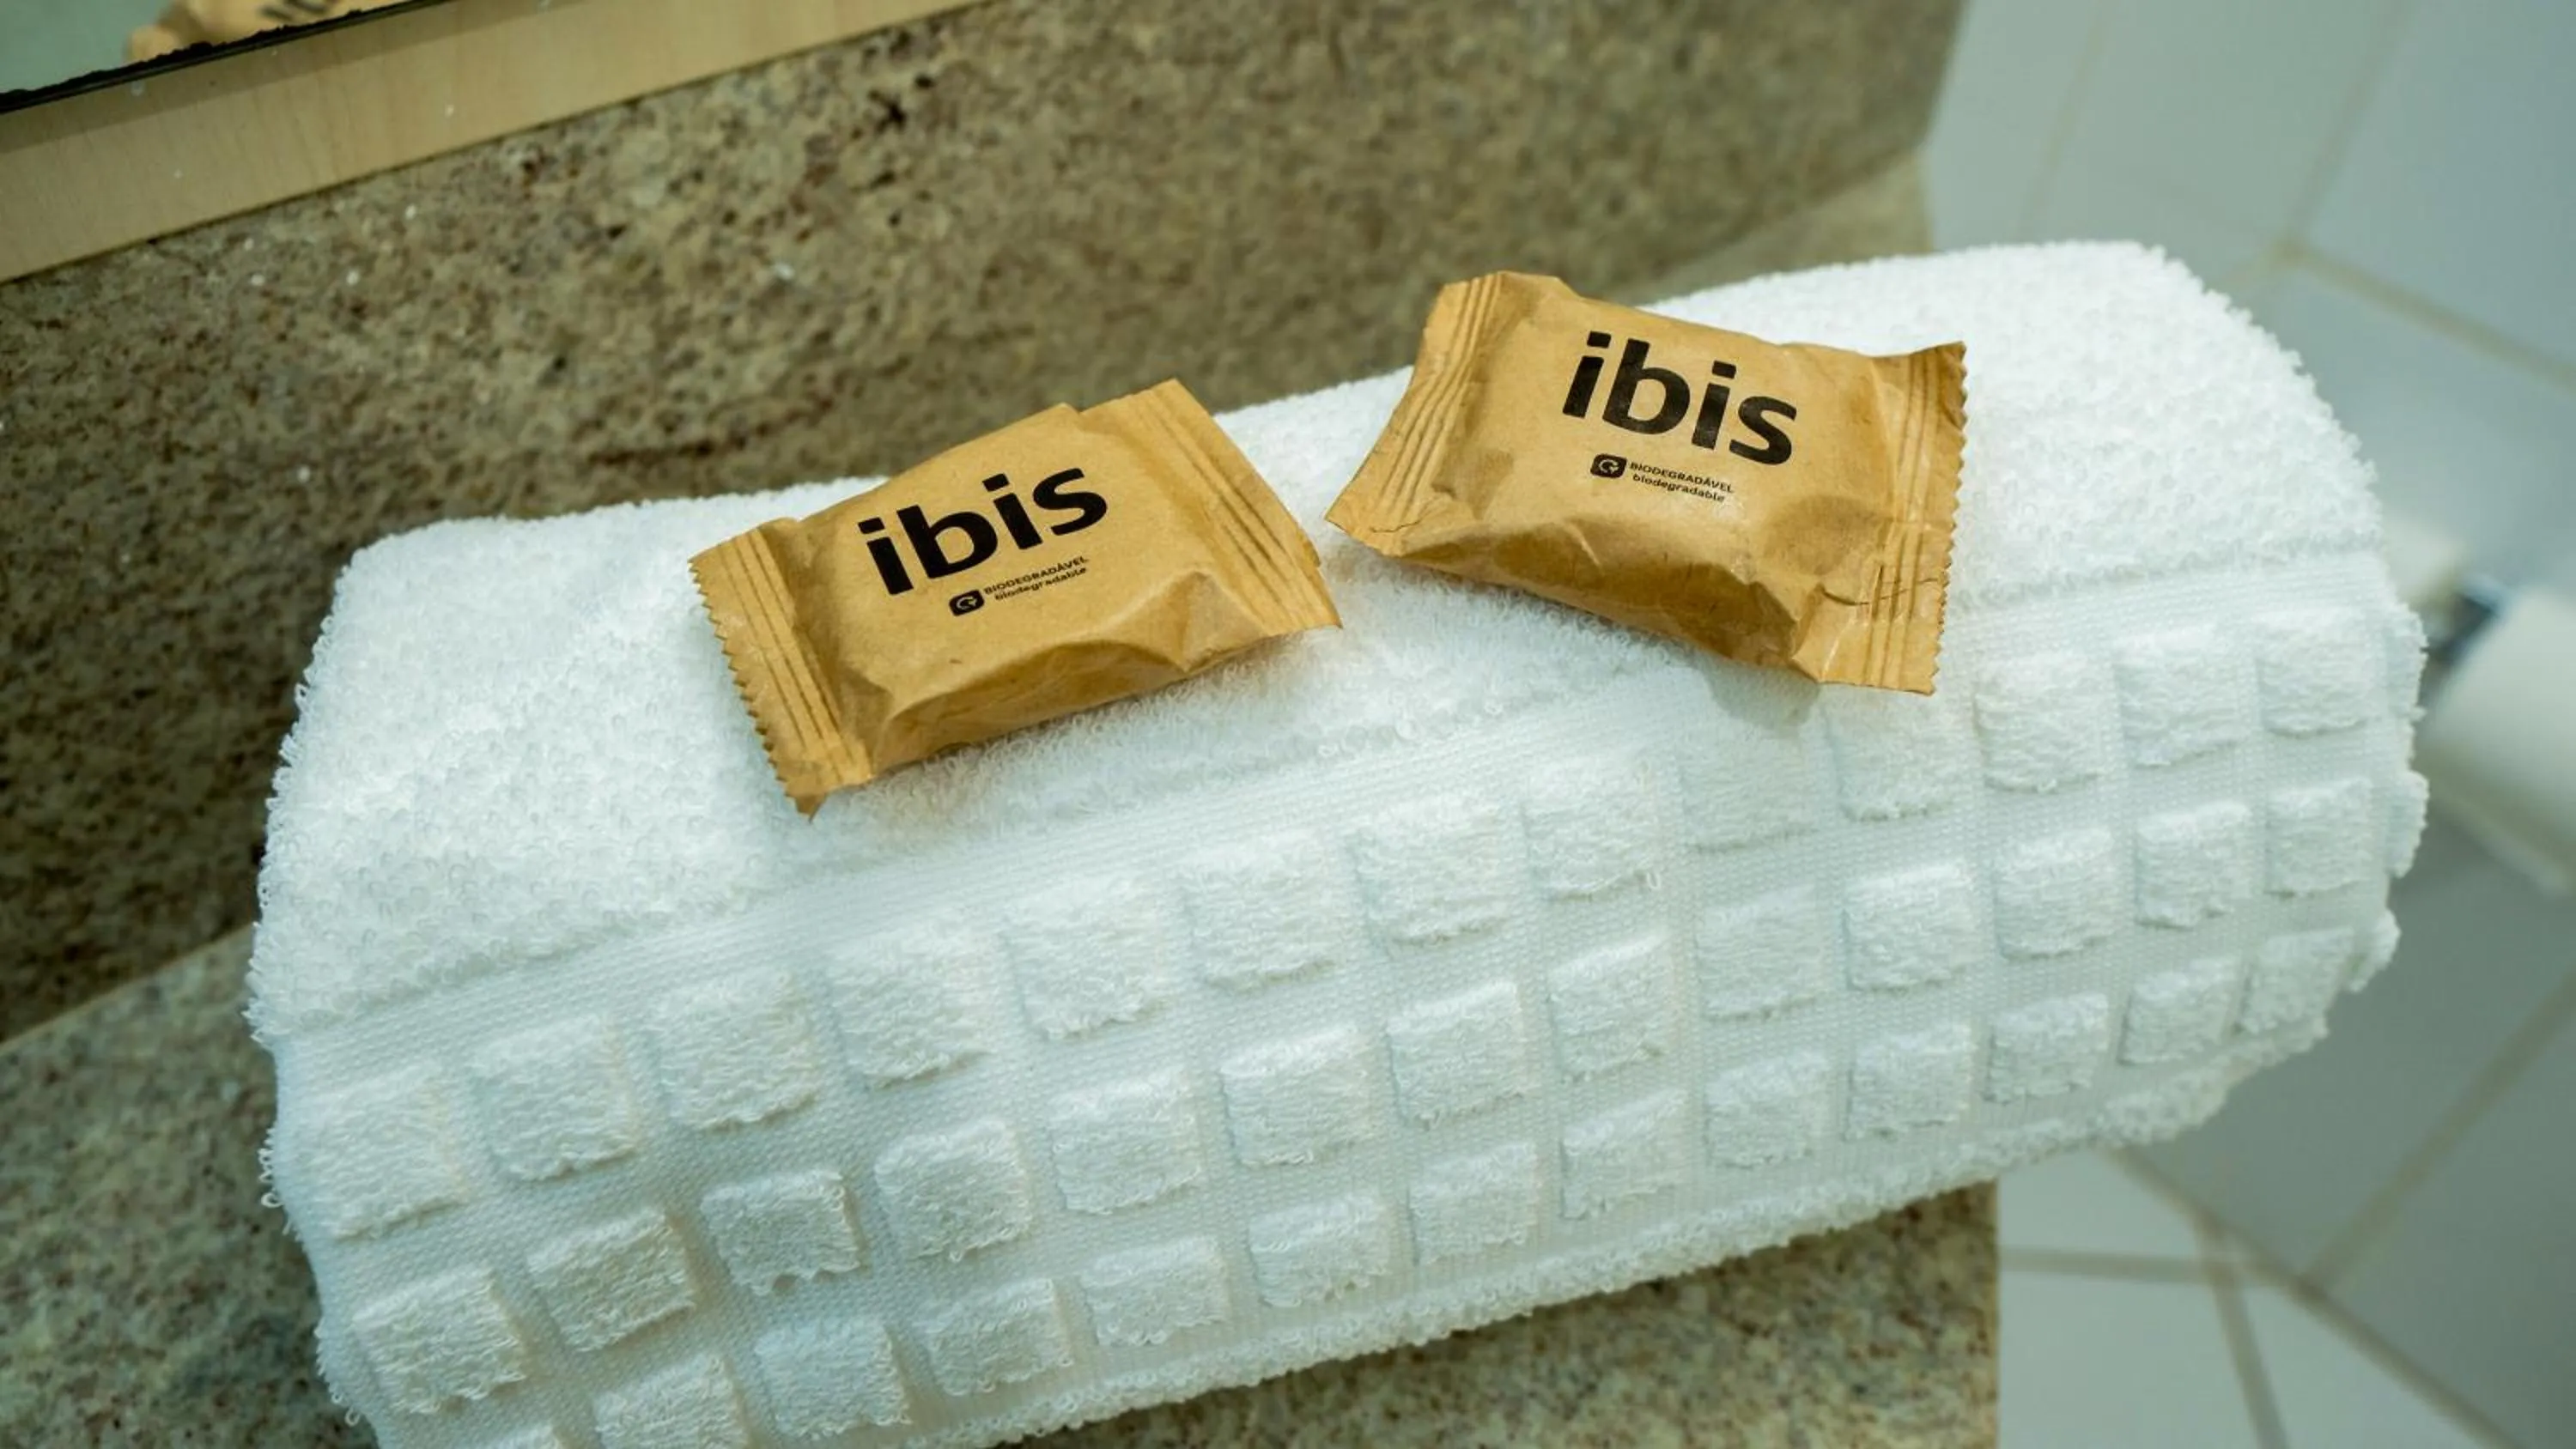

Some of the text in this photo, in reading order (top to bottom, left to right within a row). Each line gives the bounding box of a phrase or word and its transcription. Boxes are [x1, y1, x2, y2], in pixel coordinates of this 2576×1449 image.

[1562, 330, 1797, 465] ibis
[1629, 461, 1735, 494] BIODEGRADÁVEL
[1632, 473, 1725, 503] biodegradable
[858, 468, 1108, 595] ibis
[983, 555, 1089, 596] BIODEGRADÁVEL
[994, 567, 1087, 602] biodegradable
